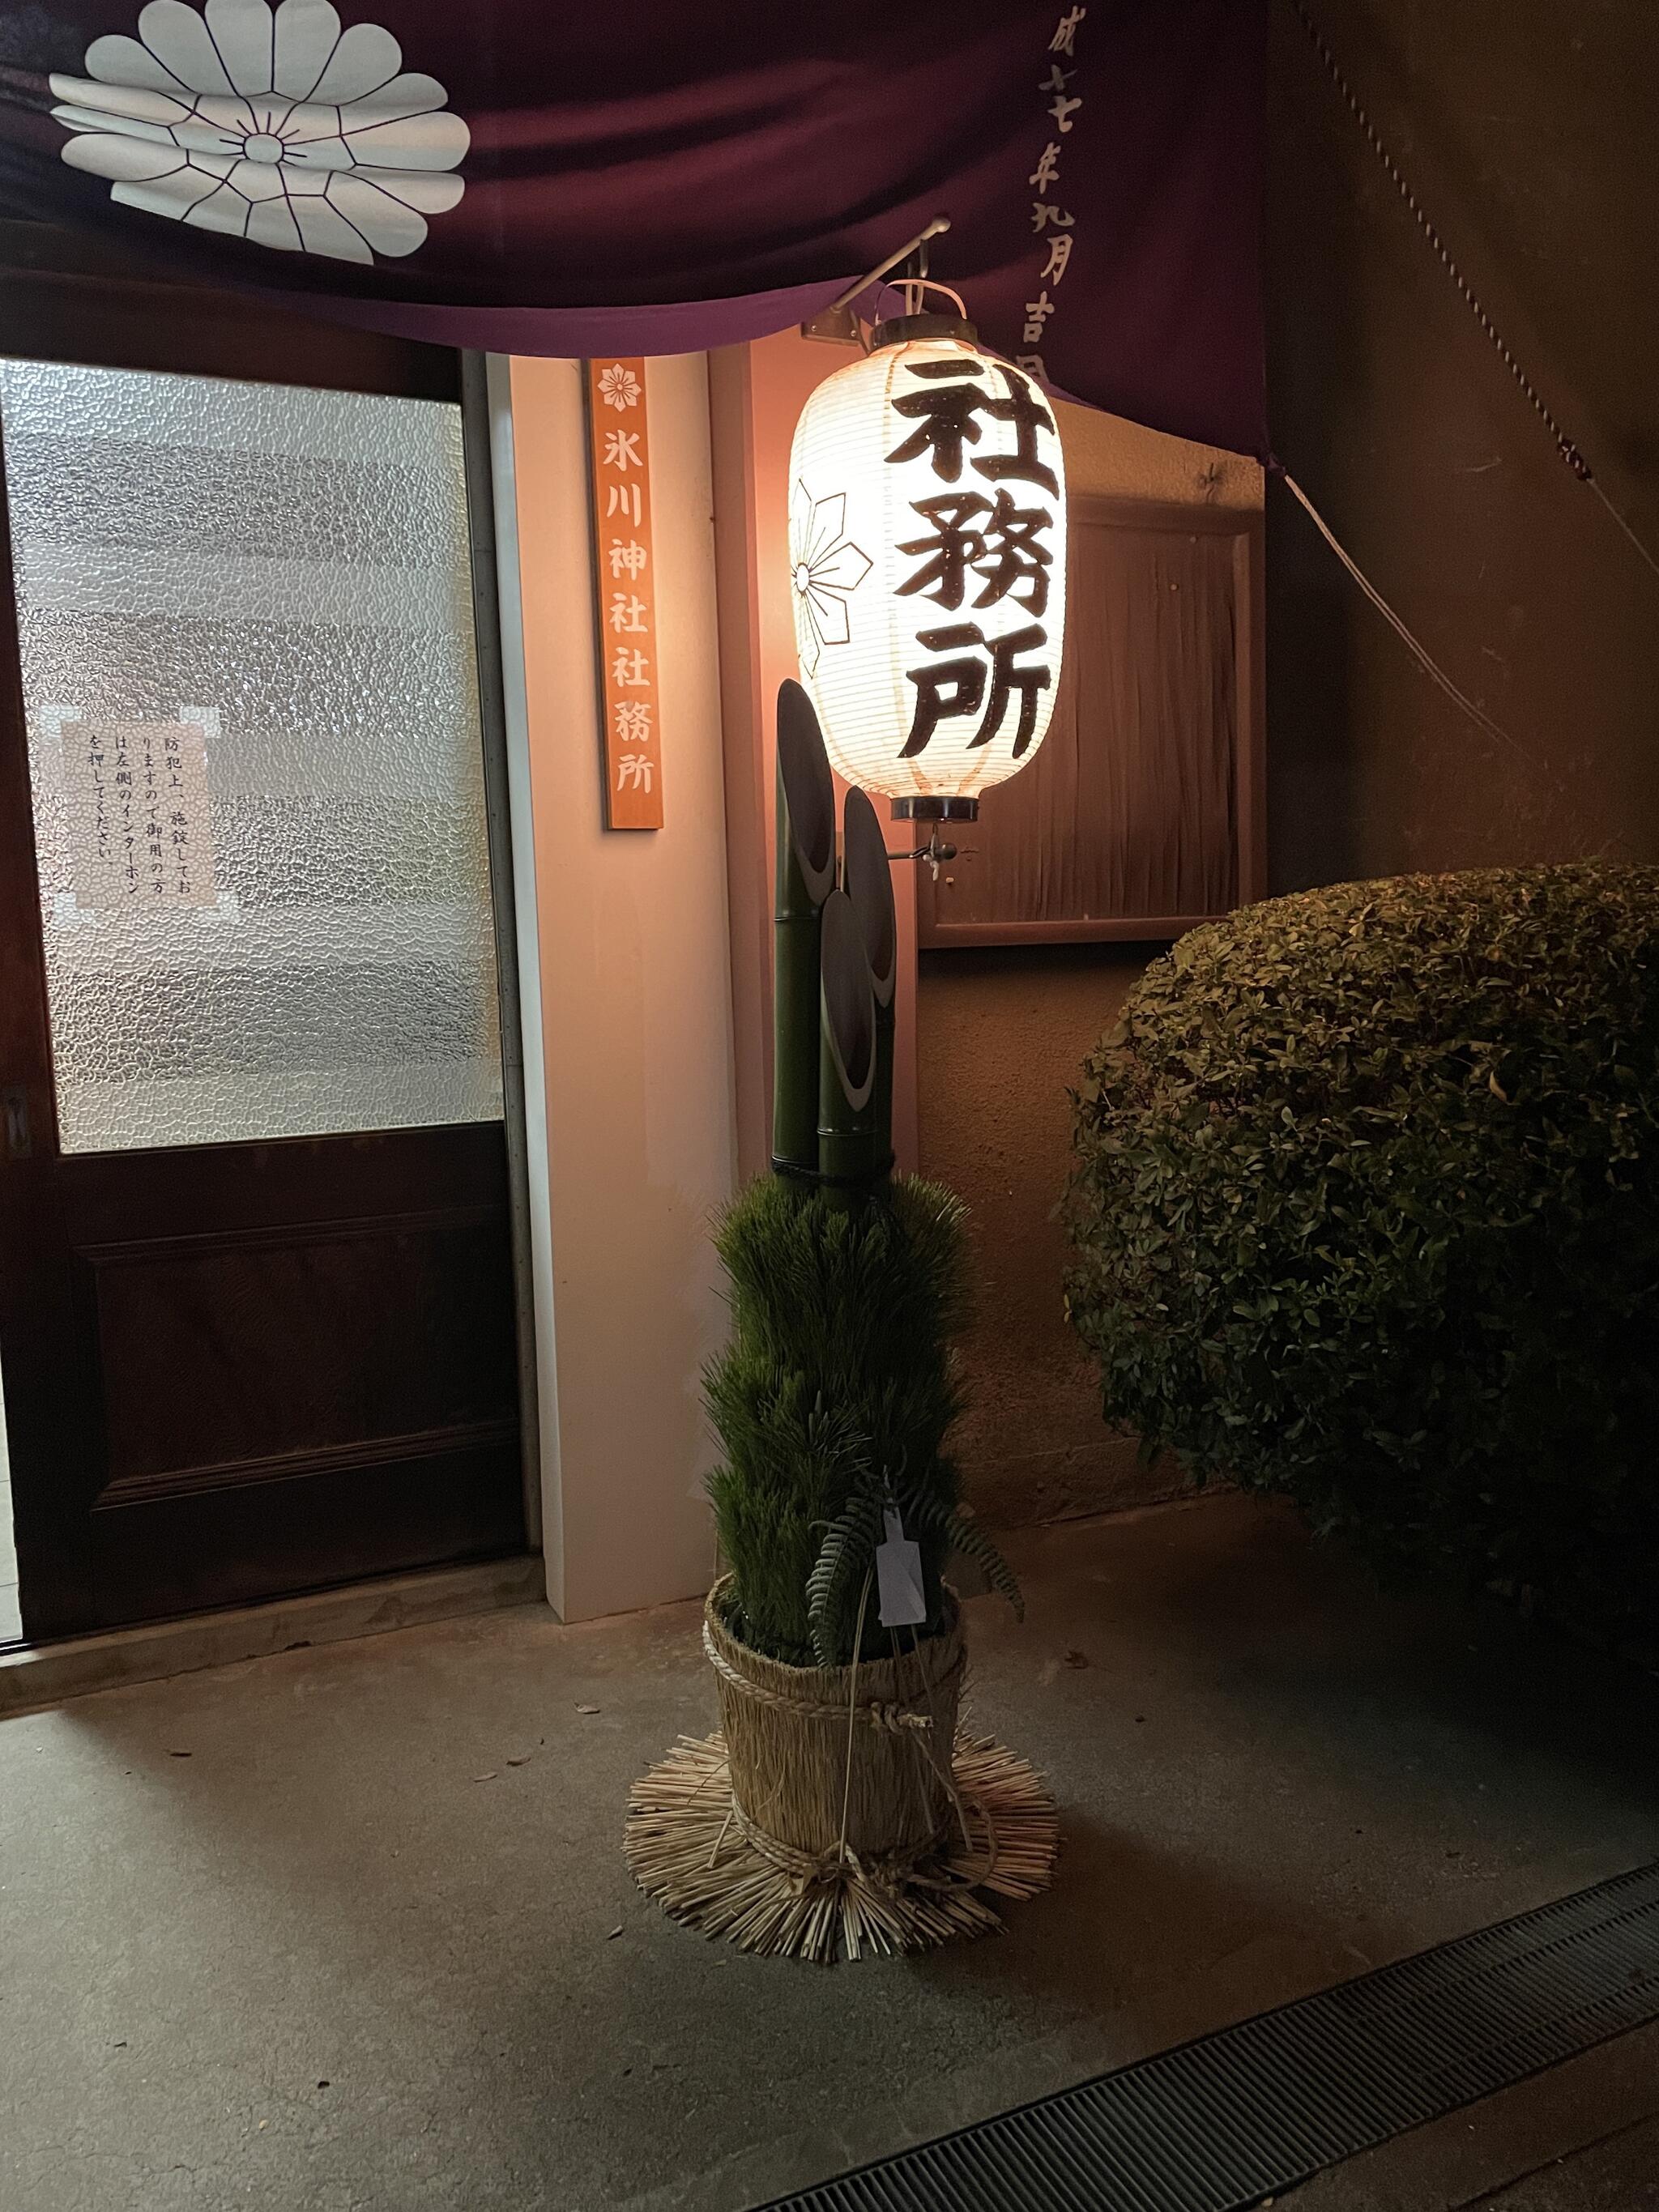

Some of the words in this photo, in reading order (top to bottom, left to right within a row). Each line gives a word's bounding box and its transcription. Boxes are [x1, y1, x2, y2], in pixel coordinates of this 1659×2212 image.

[602, 428, 655, 794] 氷川神社社務所
[885, 358, 1059, 759] 社務所
[115, 735, 139, 894] は左側のインターホン
[141, 739, 166, 894] りますので御用の方
[164, 736, 190, 894] 防犯上、施錠してお
